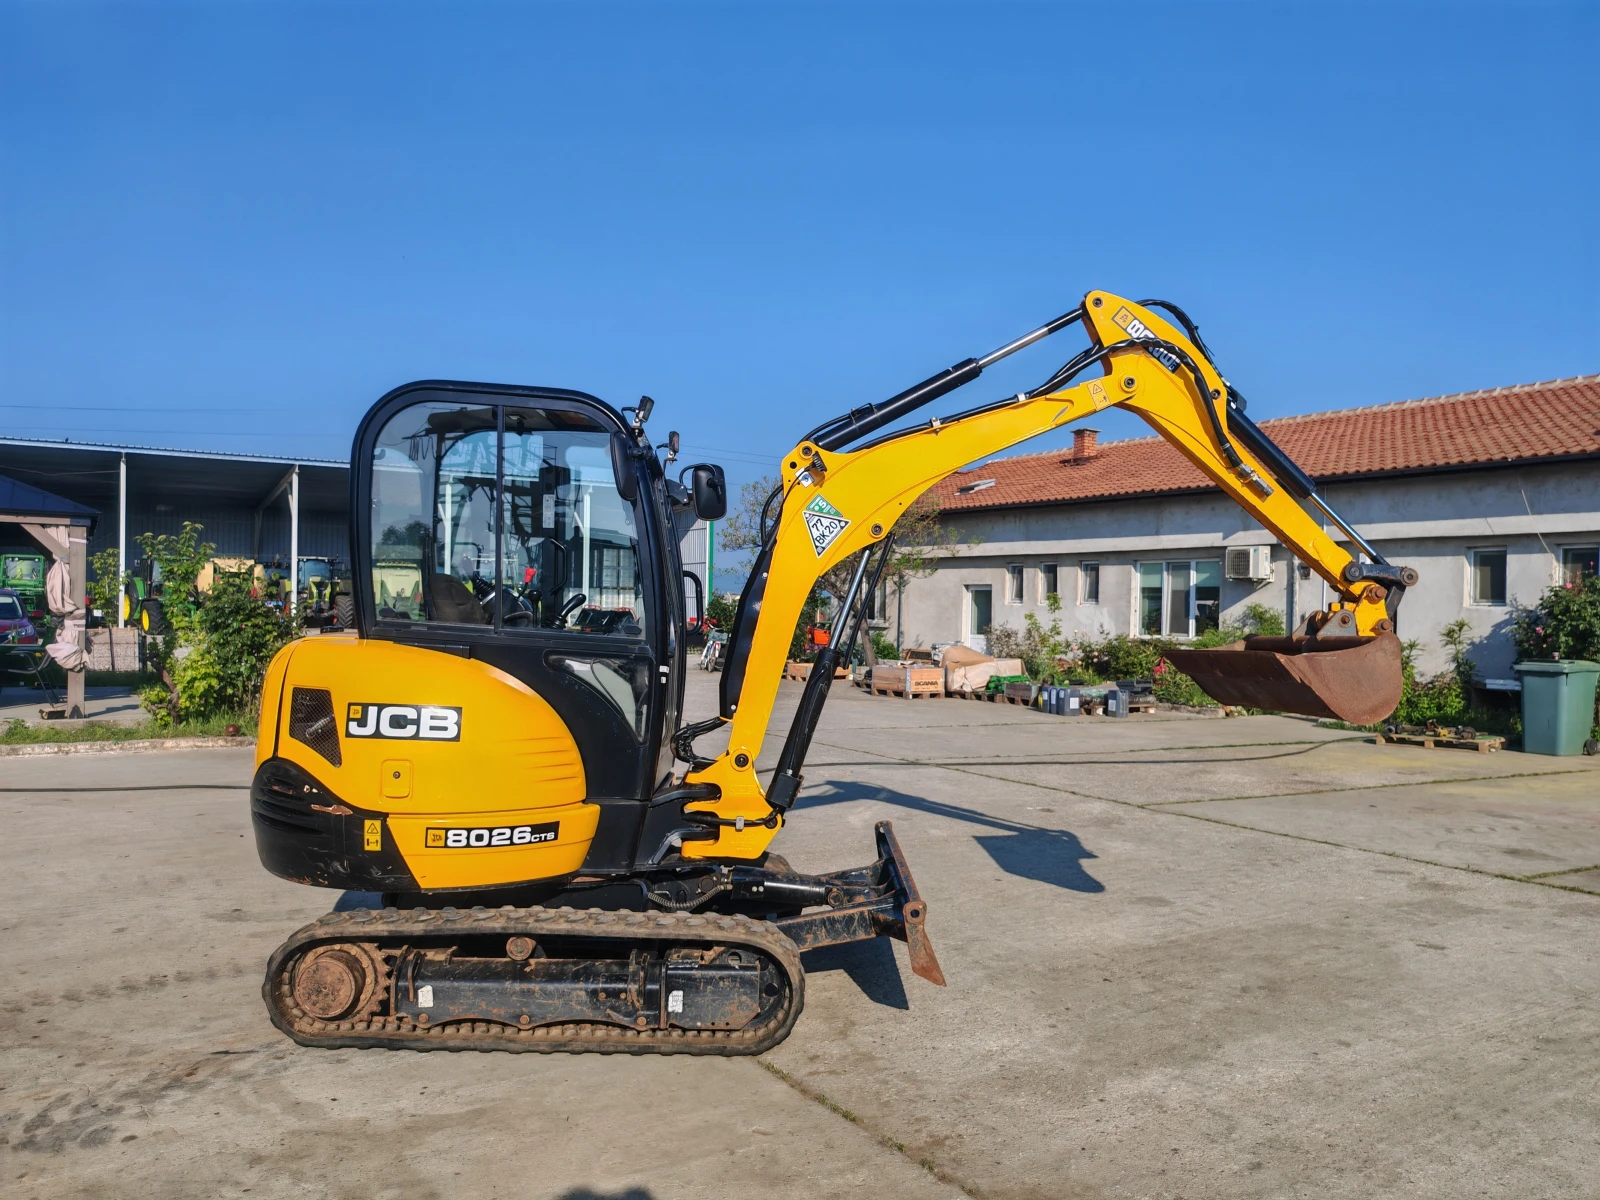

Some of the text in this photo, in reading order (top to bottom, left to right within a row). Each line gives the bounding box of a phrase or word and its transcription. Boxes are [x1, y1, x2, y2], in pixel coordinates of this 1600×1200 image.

[811, 518, 825, 532] 77
[815, 521, 838, 545] BK20
[348, 705, 459, 739] JCB
